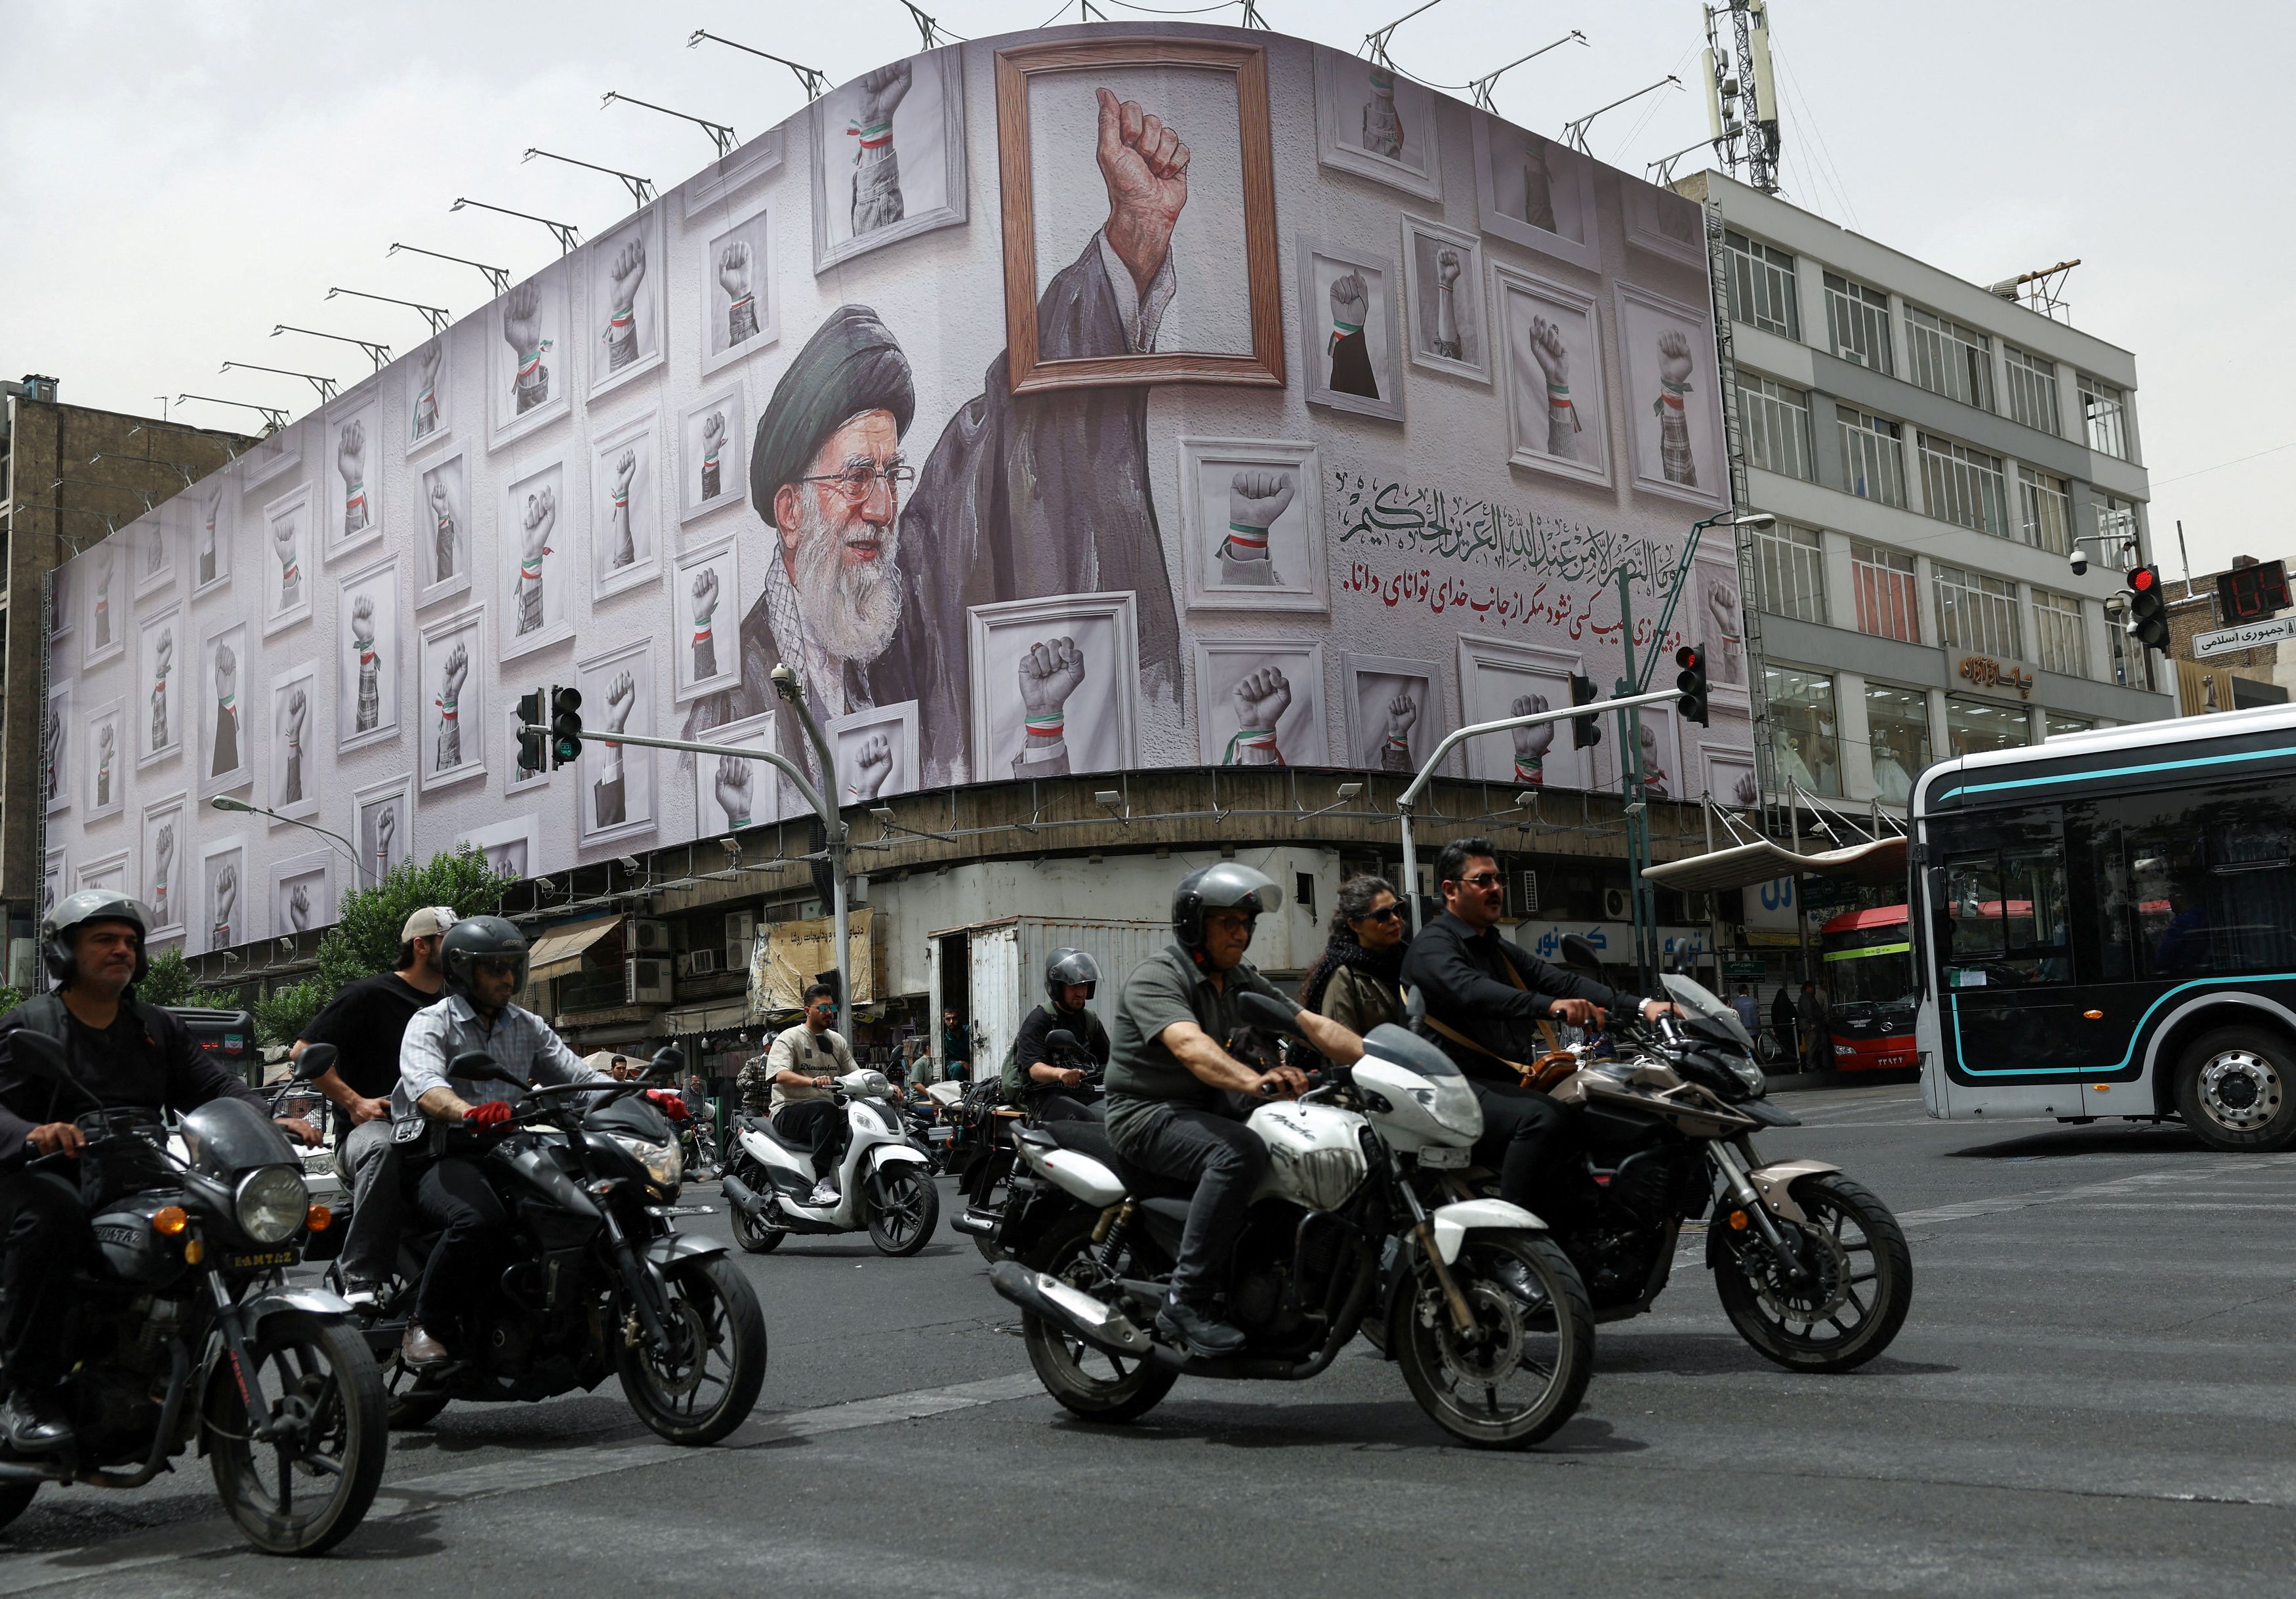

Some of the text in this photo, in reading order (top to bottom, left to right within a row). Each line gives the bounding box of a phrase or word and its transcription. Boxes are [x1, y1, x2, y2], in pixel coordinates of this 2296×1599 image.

[1383, 569, 1430, 608] توانای
[1430, 576, 1469, 613] خدای
[1471, 586, 1510, 627] جانب
[1509, 591, 1523, 619] از
[1523, 582, 1546, 623] مگر
[1547, 594, 1572, 626] نشود
[1569, 589, 1602, 640] کسی
[2202, 626, 2284, 650] جمهوری اسلامی
[1987, 659, 2032, 699] پاساژ
[1536, 926, 1559, 957] نور
